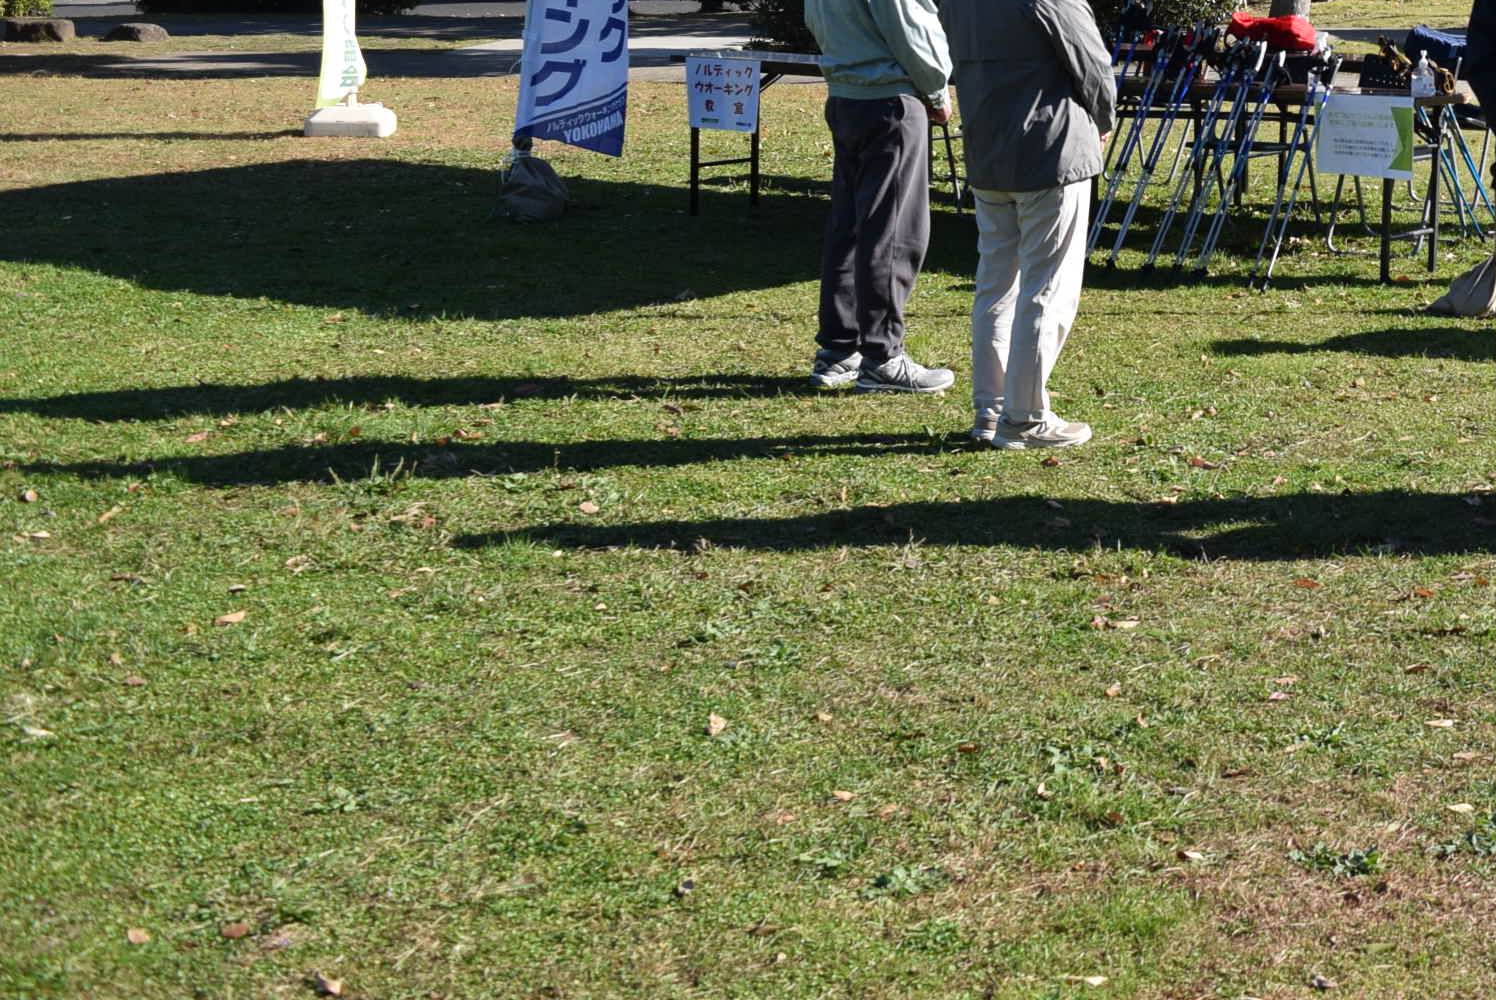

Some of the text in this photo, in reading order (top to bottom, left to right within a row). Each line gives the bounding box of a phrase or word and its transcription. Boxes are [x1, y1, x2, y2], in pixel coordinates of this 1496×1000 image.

[695, 63, 753, 79] ノルディック
[563, 110, 624, 144] YOKOHAMA
